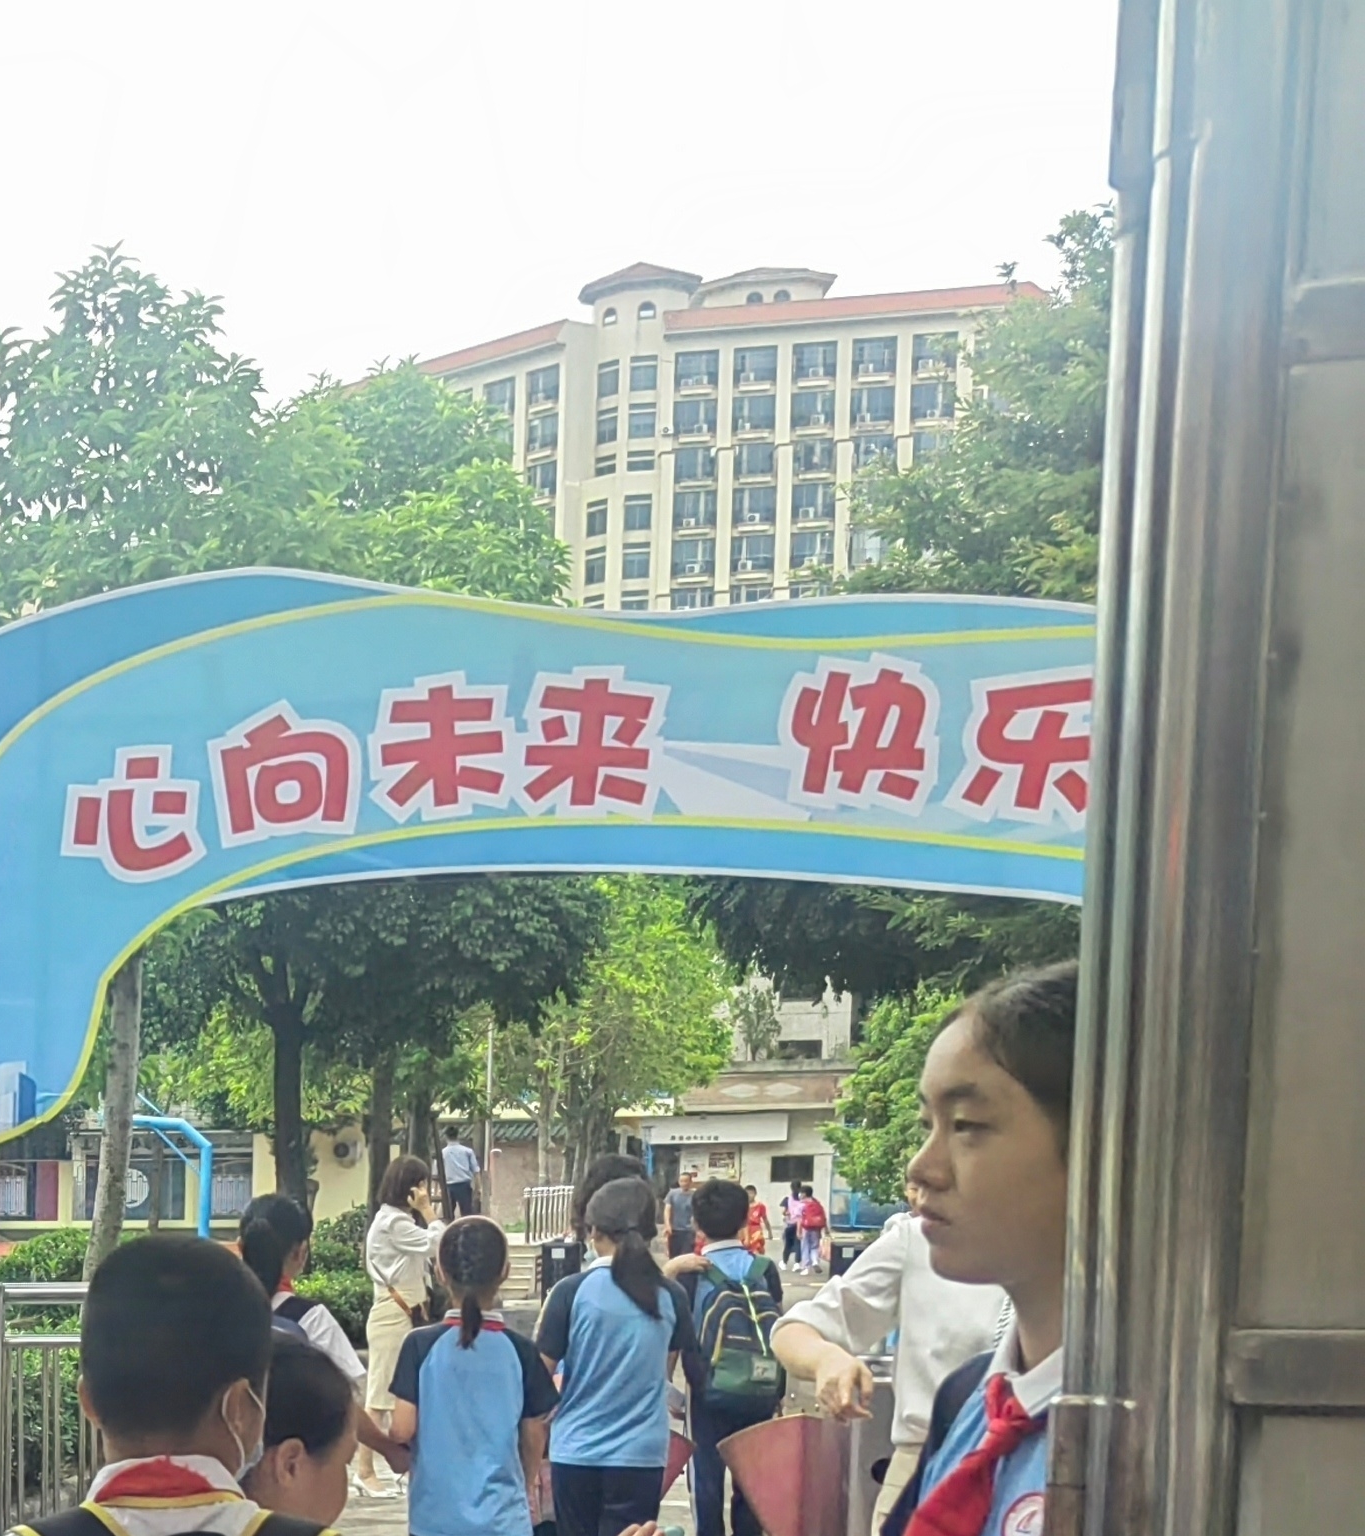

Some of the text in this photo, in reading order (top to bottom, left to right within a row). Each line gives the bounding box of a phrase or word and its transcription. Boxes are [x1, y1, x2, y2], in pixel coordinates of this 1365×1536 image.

[72, 668, 1094, 874] 心向未来 快乐
